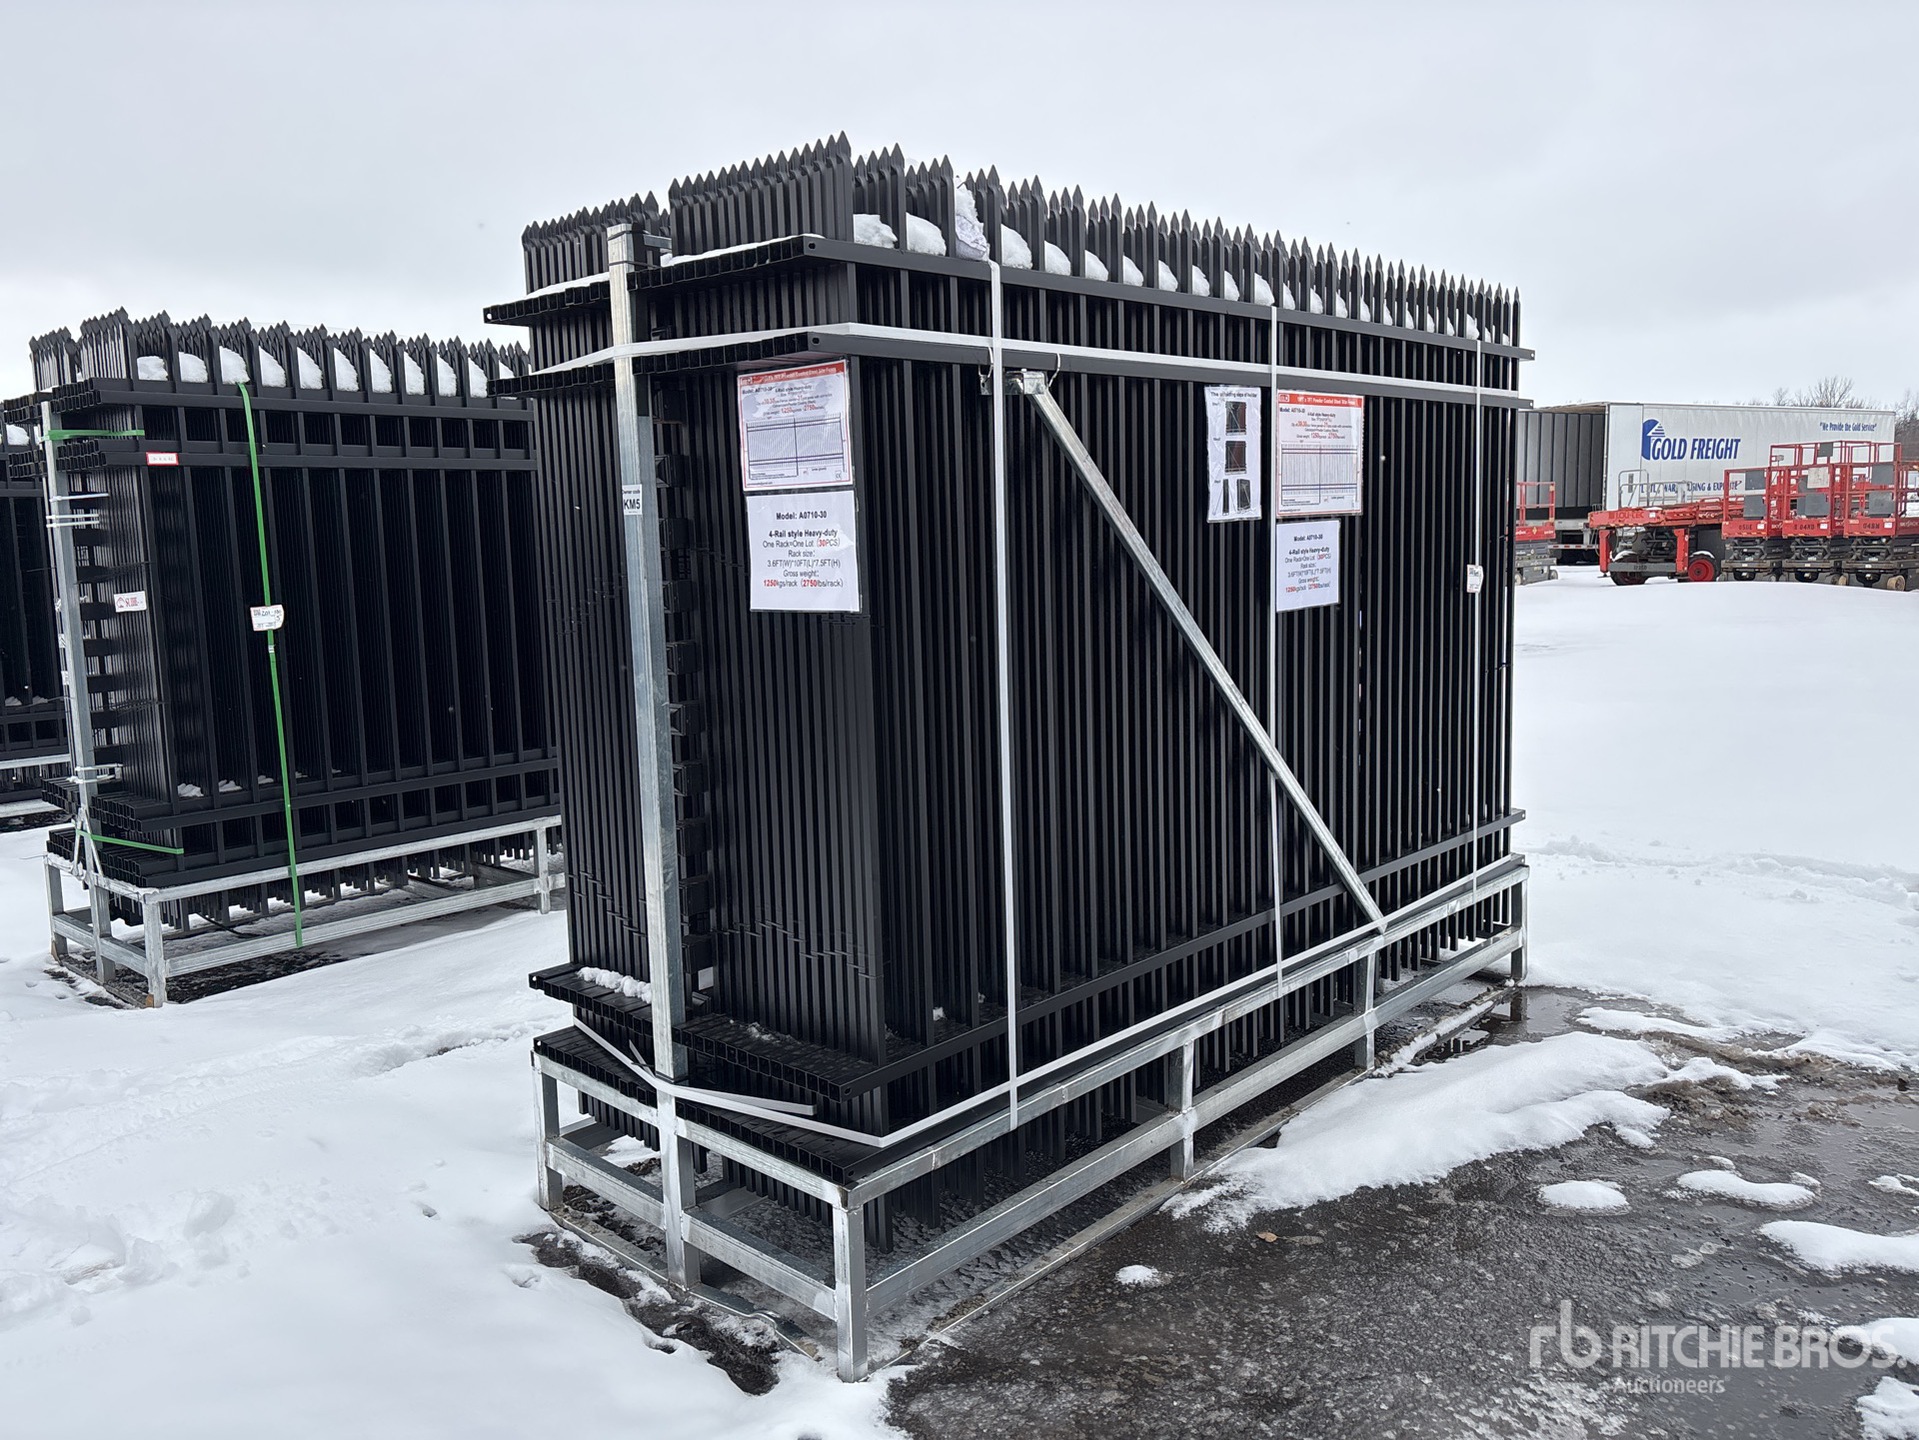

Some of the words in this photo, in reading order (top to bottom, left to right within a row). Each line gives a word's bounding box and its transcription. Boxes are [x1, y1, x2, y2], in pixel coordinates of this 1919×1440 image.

[1829, 422, 1844, 431] Provide
[1852, 422, 1861, 431] Gold
[1652, 438, 1688, 460] GOLD
[1690, 438, 1741, 460] FREIGHT
[624, 498, 640, 510] KM5
[776, 512, 797, 520] Model:
[799, 510, 827, 519] A0710-30
[788, 530, 803, 538] style
[804, 529, 838, 538] Heavy-duty
[799, 570, 819, 578] weight:
[764, 579, 797, 588] 1250kgs/rack
